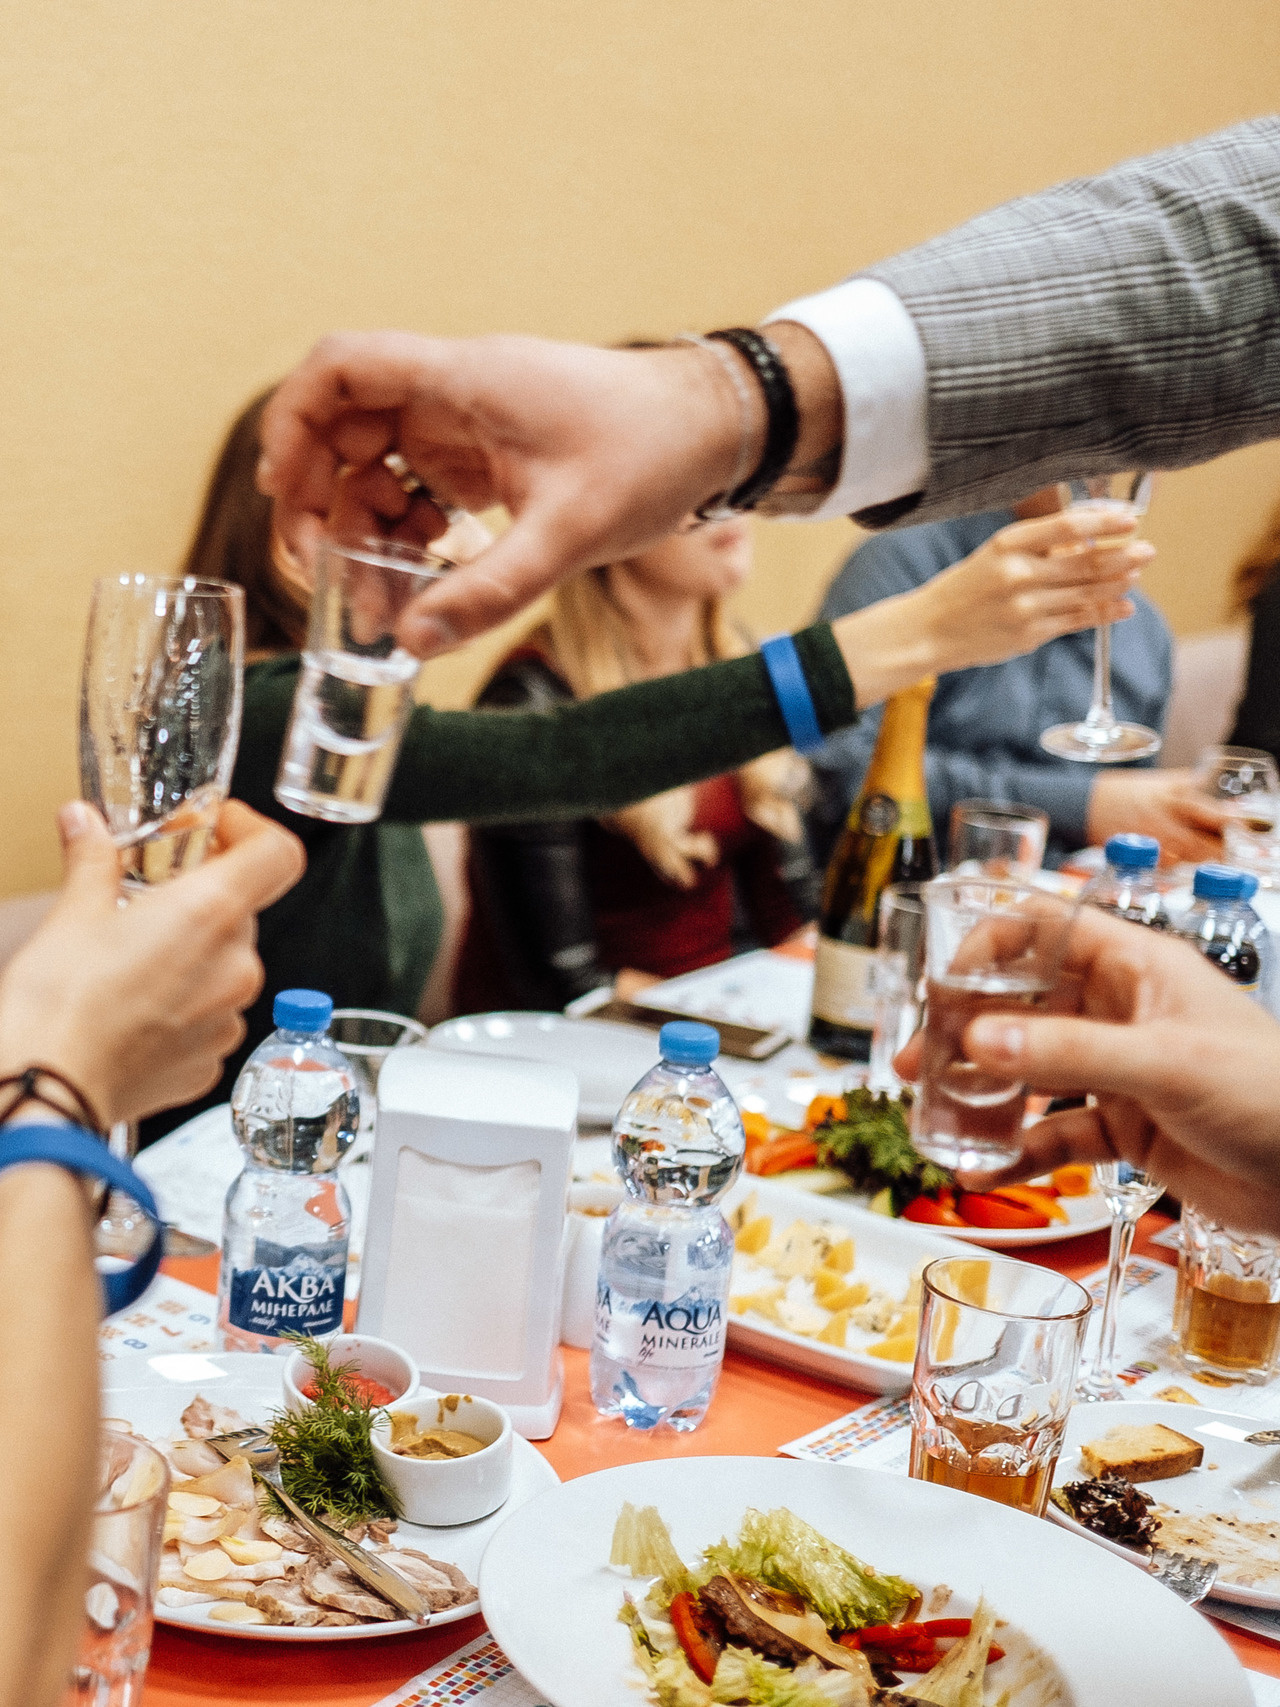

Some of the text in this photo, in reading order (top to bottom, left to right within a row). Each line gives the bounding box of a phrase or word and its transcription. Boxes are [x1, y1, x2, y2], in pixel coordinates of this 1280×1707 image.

[251, 1269, 336, 1304] АКВА
[250, 1299, 334, 1318] МІНЕРАЛЕ
[641, 1301, 721, 1335] AQUA
[641, 1331, 720, 1351] MINERALE
